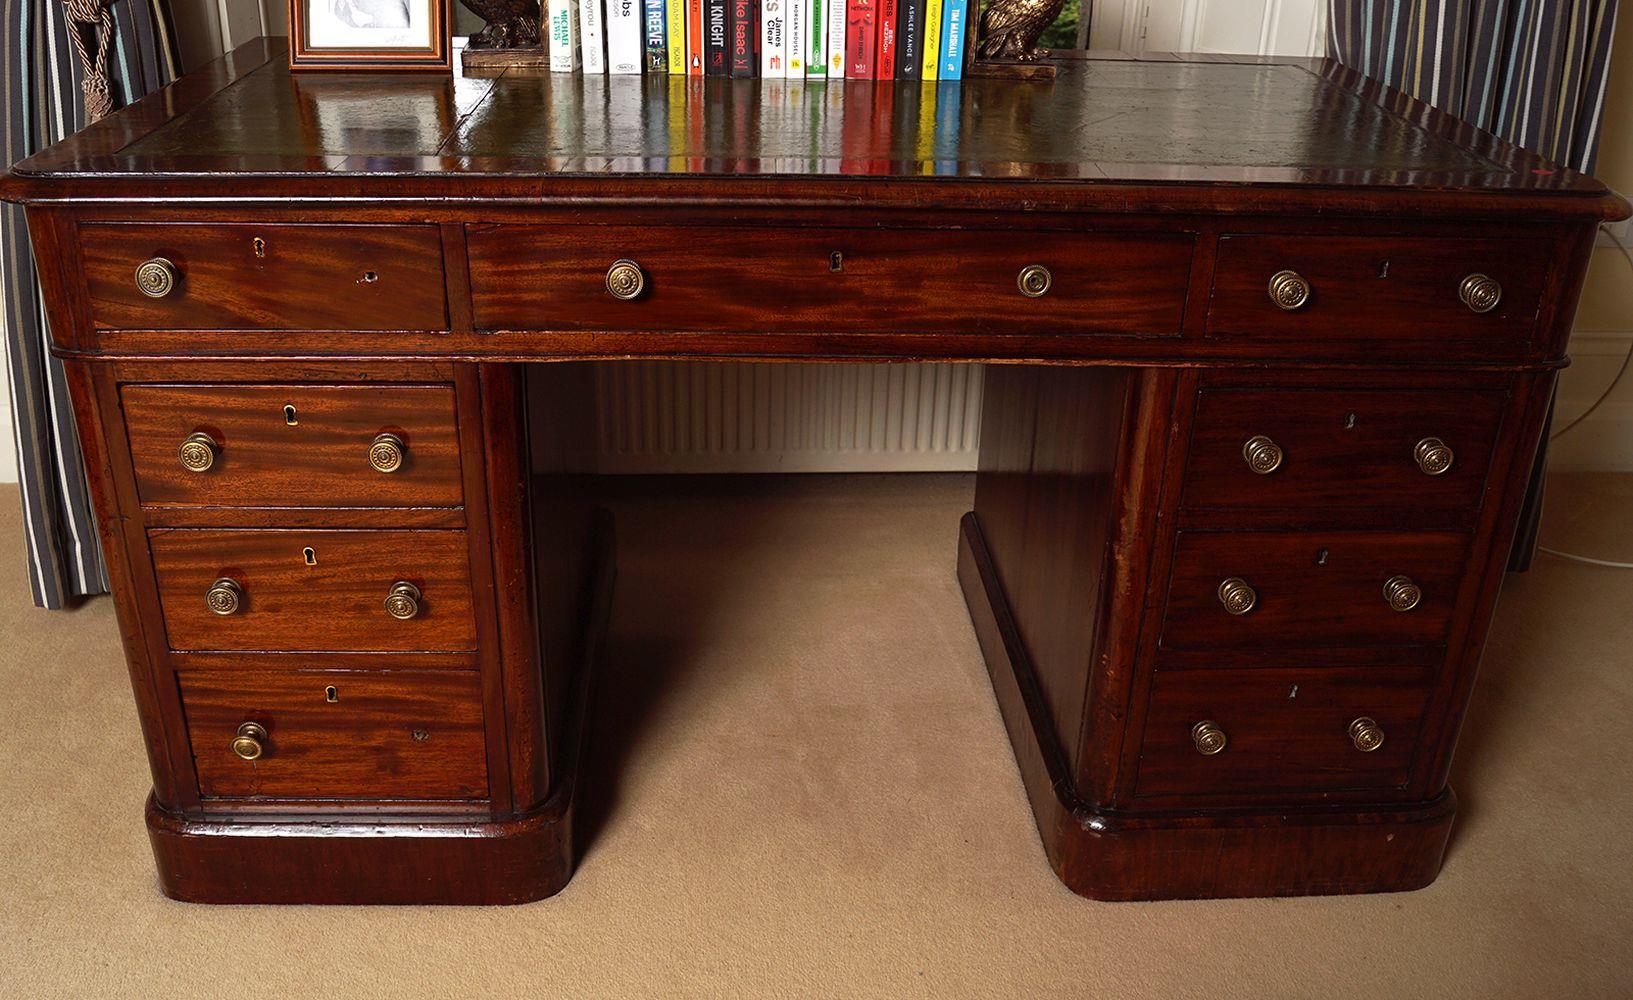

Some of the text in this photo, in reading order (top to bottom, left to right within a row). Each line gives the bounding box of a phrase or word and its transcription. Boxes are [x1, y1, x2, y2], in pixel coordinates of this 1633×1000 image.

[622, 0, 632, 17] bs
[766, 0, 779, 12] S
[553, 16, 561, 40] LEWIS
[561, 9, 569, 47] MICHAEL
[648, 11, 663, 46] REEVE
[710, 6, 724, 47] KNIGHT
[735, 20, 749, 55] Isaac
[767, 20, 775, 45] Clear
[775, 17, 783, 48] James
[948, 9, 960, 58] TIM MARSHALL
[906, 33, 914, 57] VANCE
